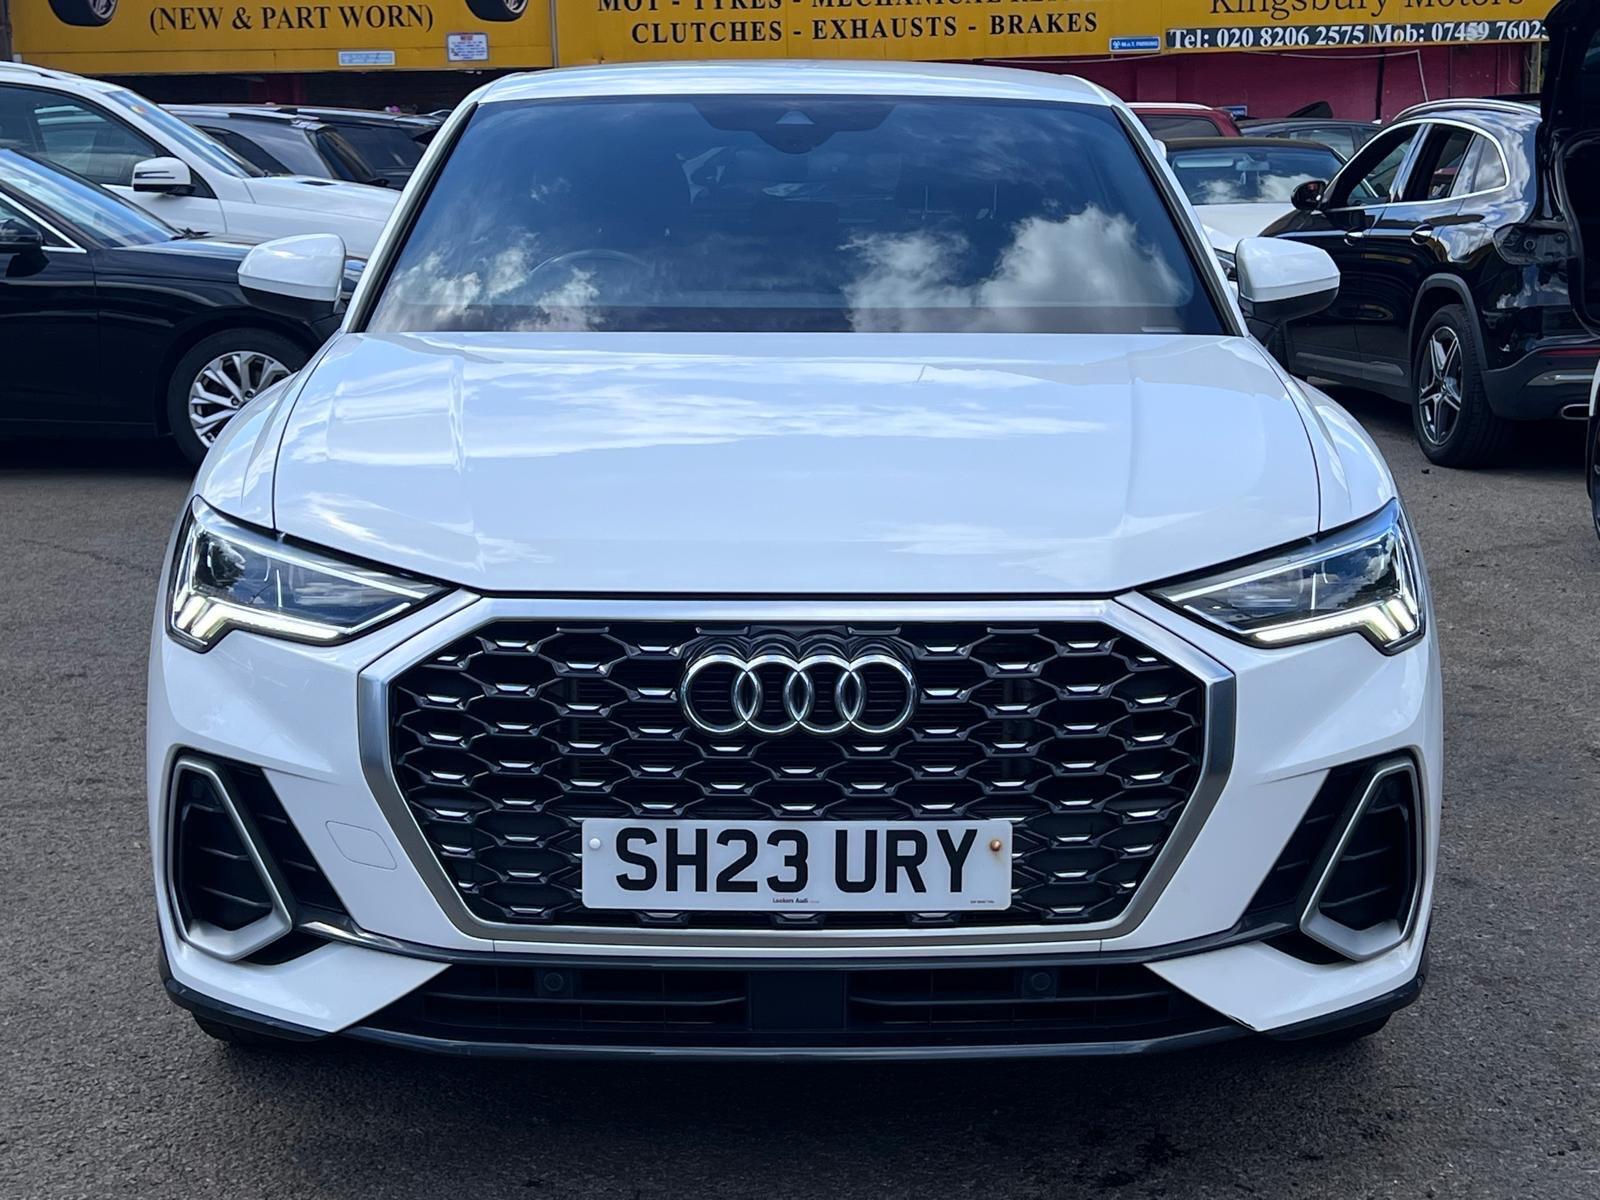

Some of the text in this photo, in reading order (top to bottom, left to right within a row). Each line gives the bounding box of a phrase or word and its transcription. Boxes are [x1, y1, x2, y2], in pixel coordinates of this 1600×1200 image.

[150, 4, 434, 36] (NEW & PART WORN)
[631, 20, 783, 44] CLUTCHES
[812, 16, 957, 40] EXHAUSTS
[989, 12, 1098, 35] BRAKES
[1169, 28, 1209, 49] Tel:
[1216, 28, 1254, 48] 020
[1260, 27, 1309, 47] 8206
[1315, 25, 1365, 45] 2575
[1370, 23, 1425, 44] Mob:
[615, 827, 978, 895] SH23 URY
